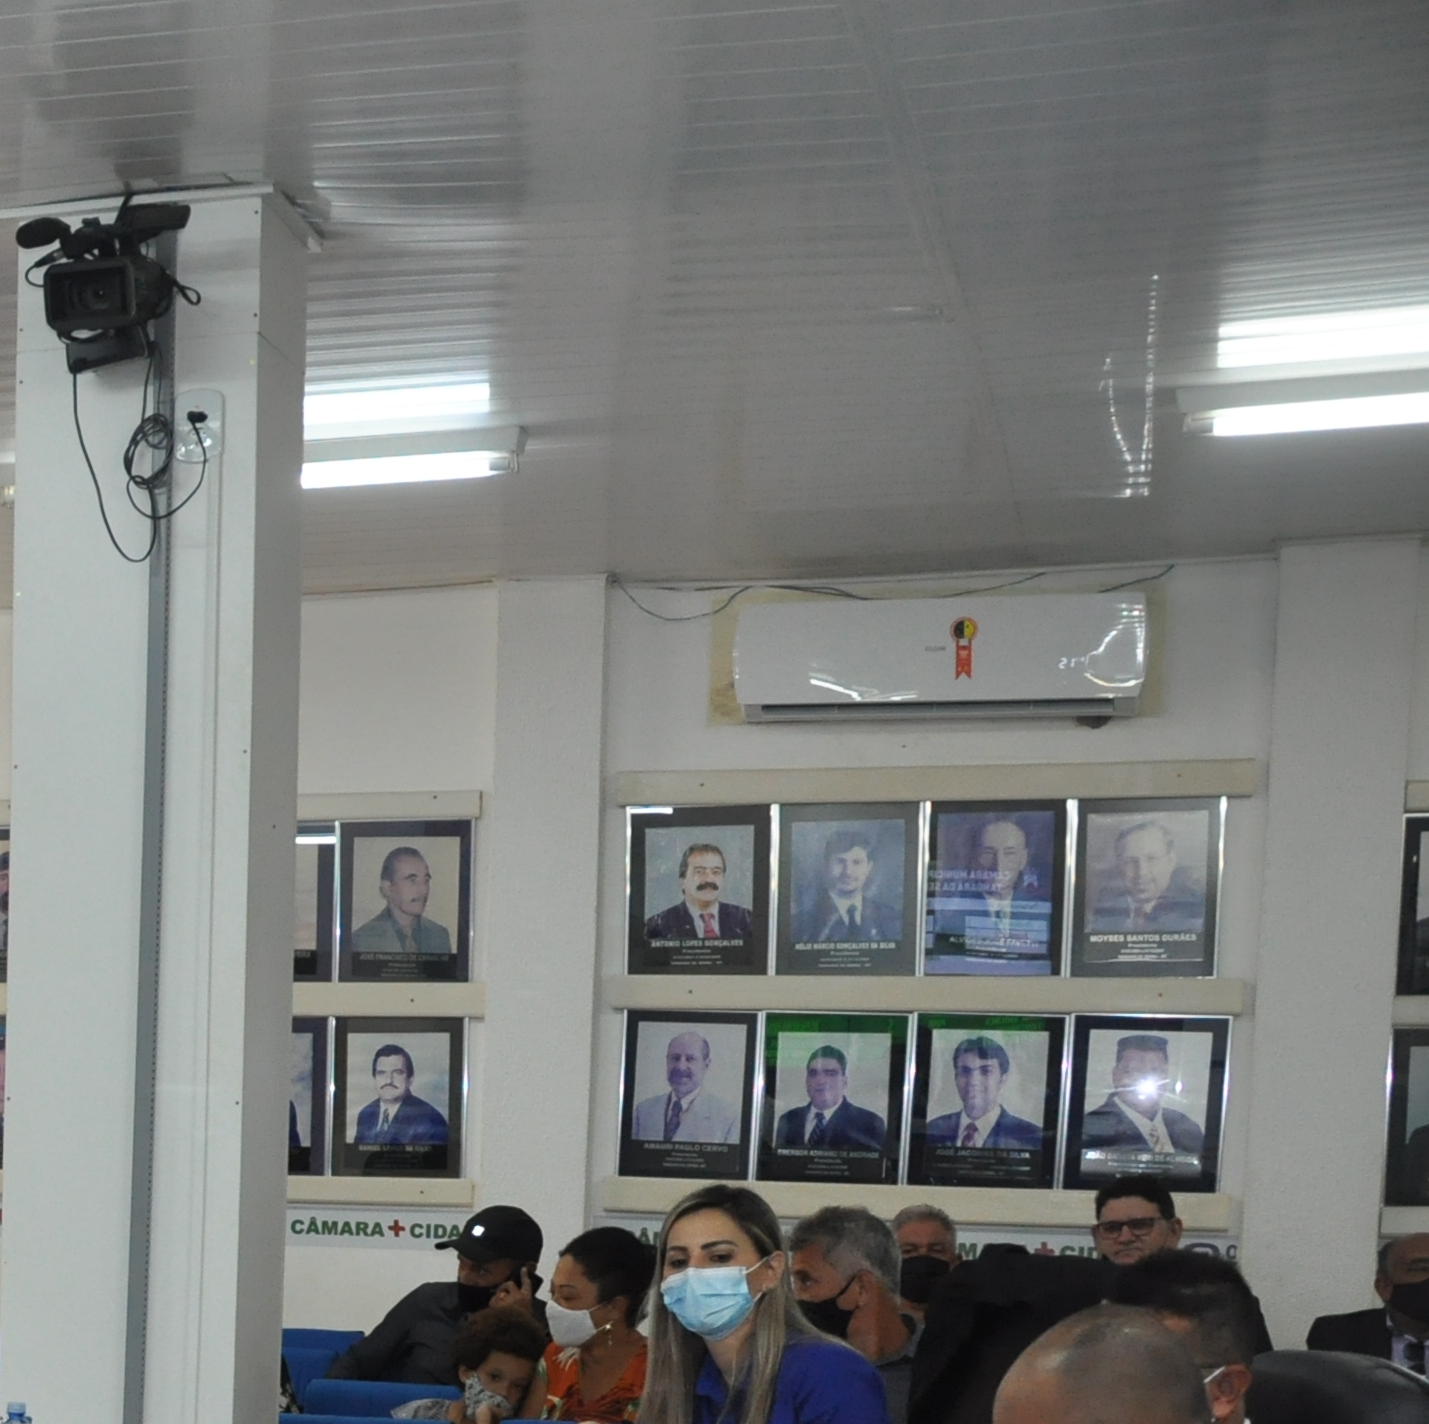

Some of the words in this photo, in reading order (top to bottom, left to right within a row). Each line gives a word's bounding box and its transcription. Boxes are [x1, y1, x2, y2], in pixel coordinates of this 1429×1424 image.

[1126, 934, 1161, 942] SANTOS
[704, 939, 744, 948] GONÇALVES
[674, 1142, 701, 1151] PAULO
[848, 1151, 880, 1159] ANDRADE
[290, 1216, 385, 1237] CÂMARA
